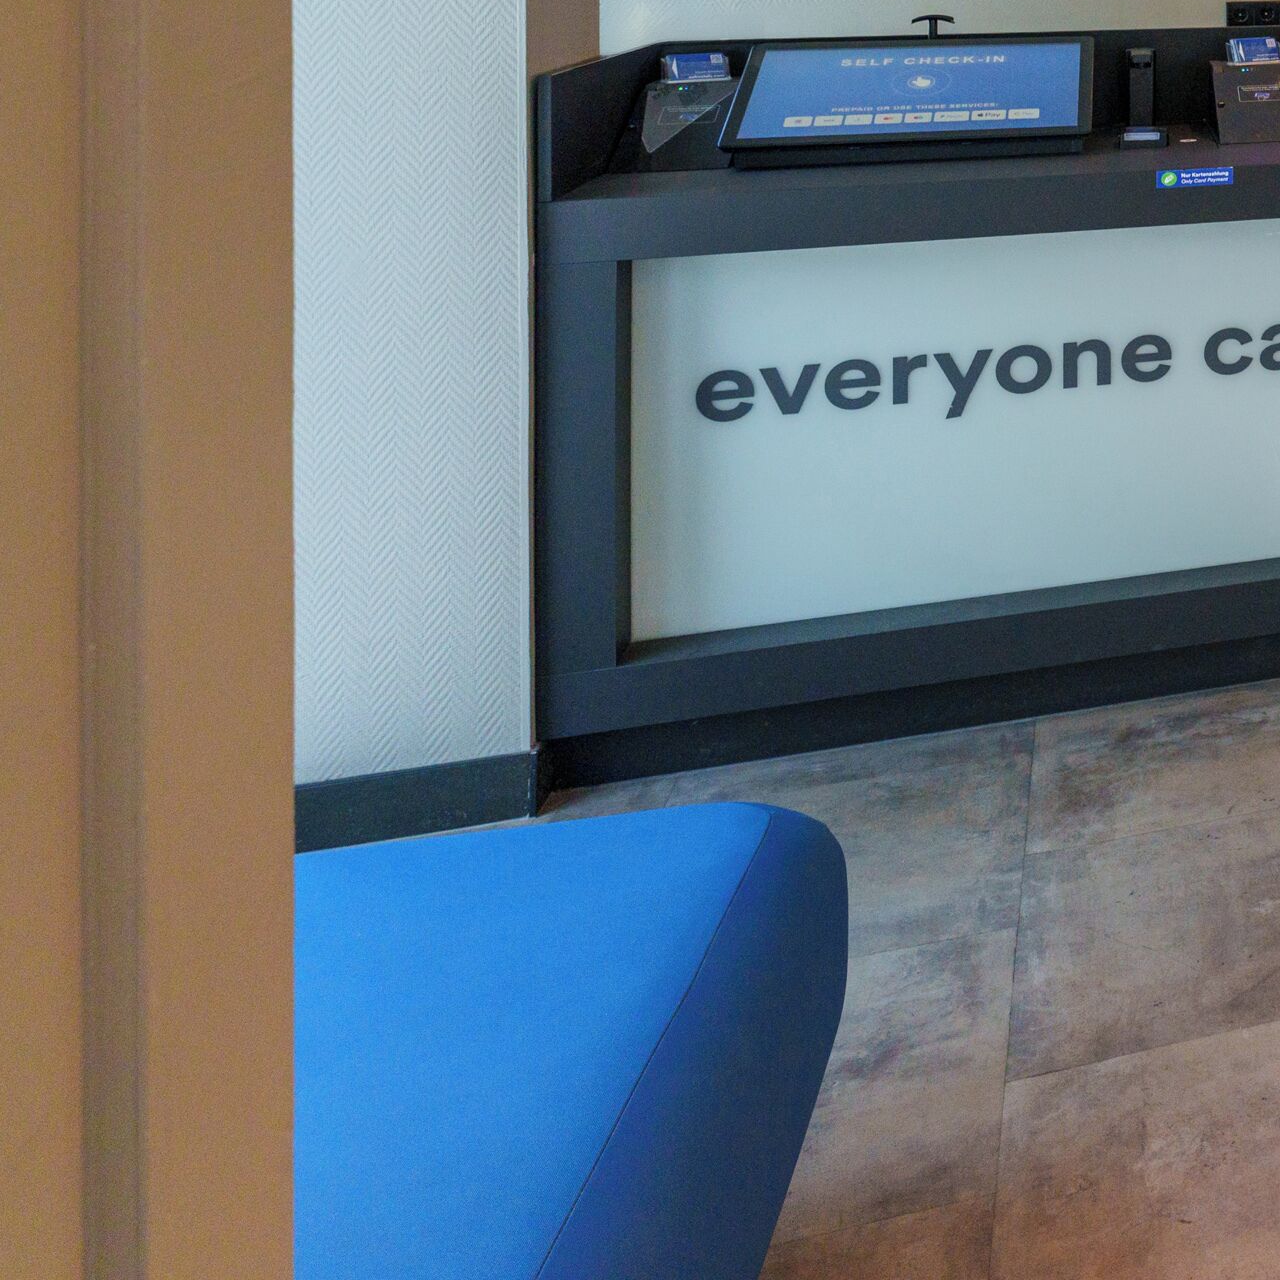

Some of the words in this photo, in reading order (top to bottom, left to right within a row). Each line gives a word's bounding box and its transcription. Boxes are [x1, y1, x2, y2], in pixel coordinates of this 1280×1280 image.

[841, 58, 894, 67] SELF
[903, 55, 1005, 65] CHECK-IN
[694, 332, 1173, 421] everyone
